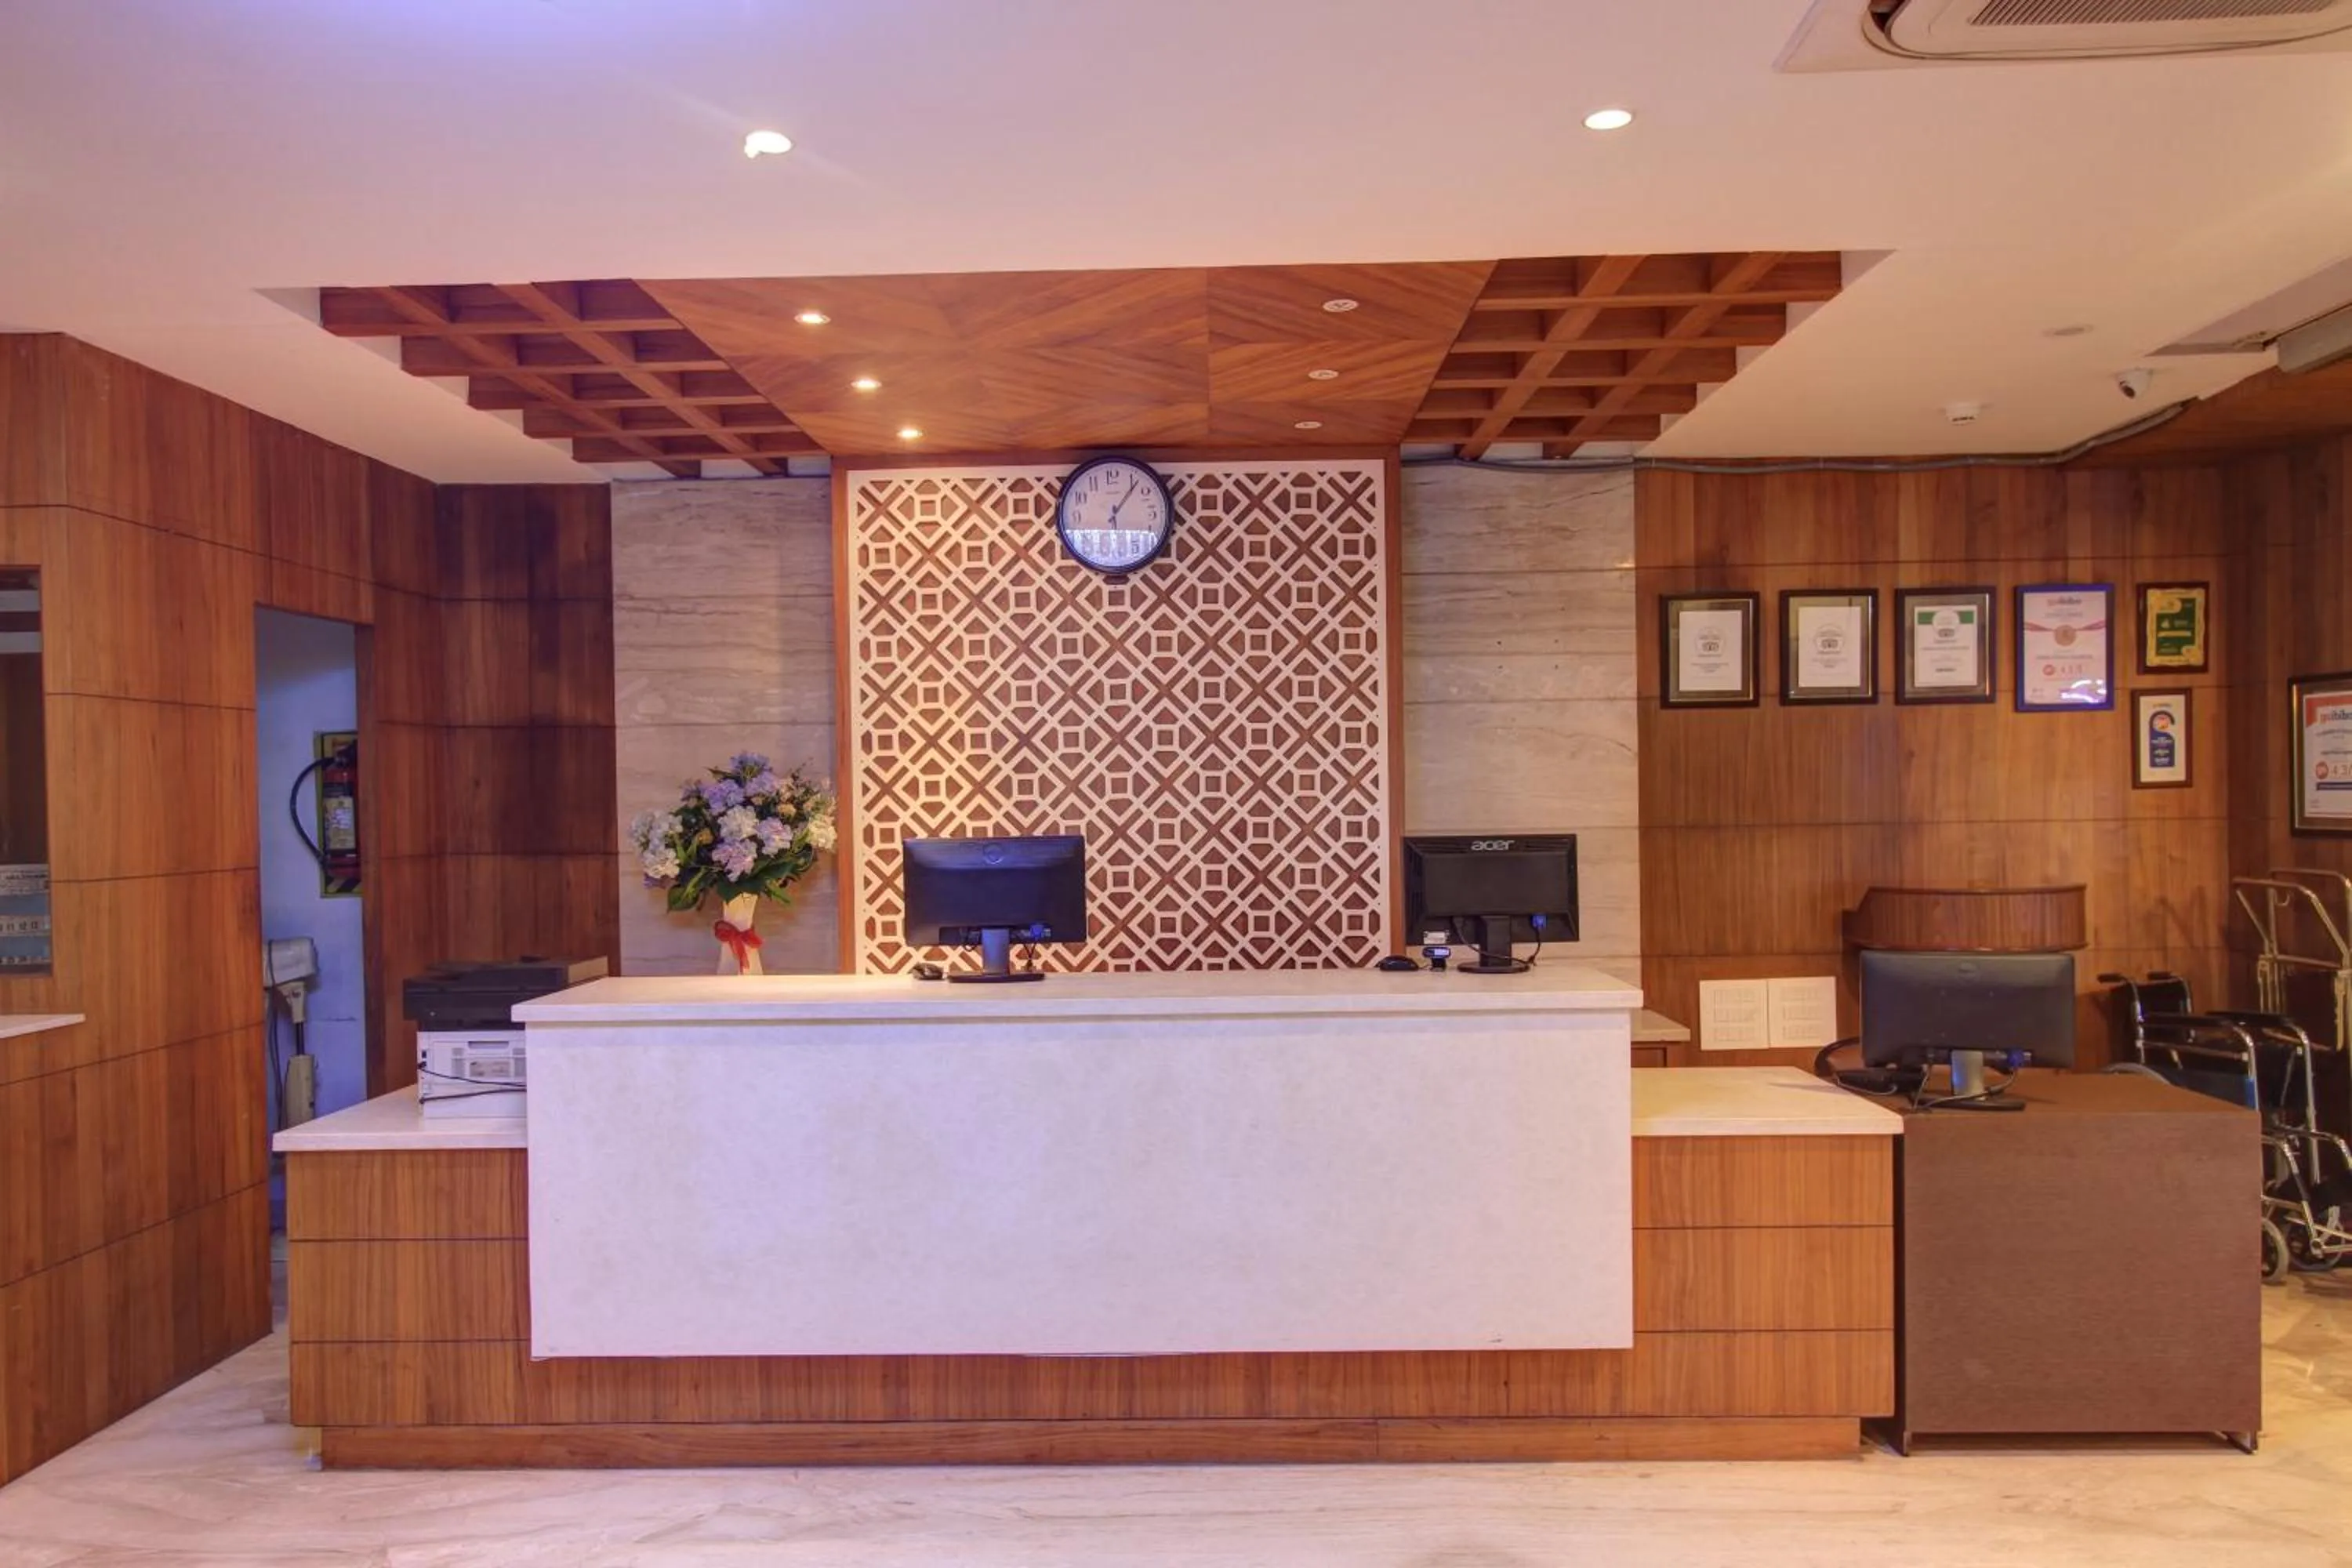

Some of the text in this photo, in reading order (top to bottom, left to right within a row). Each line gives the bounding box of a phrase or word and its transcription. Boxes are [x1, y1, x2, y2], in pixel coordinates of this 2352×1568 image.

[1089, 475, 1098, 492] 11
[1106, 469, 1120, 485] 12
[1075, 490, 1087, 506] 10
[1141, 487, 1151, 501] 2
[1073, 510, 1081, 524] 9
[1471, 840, 1515, 851] acer
